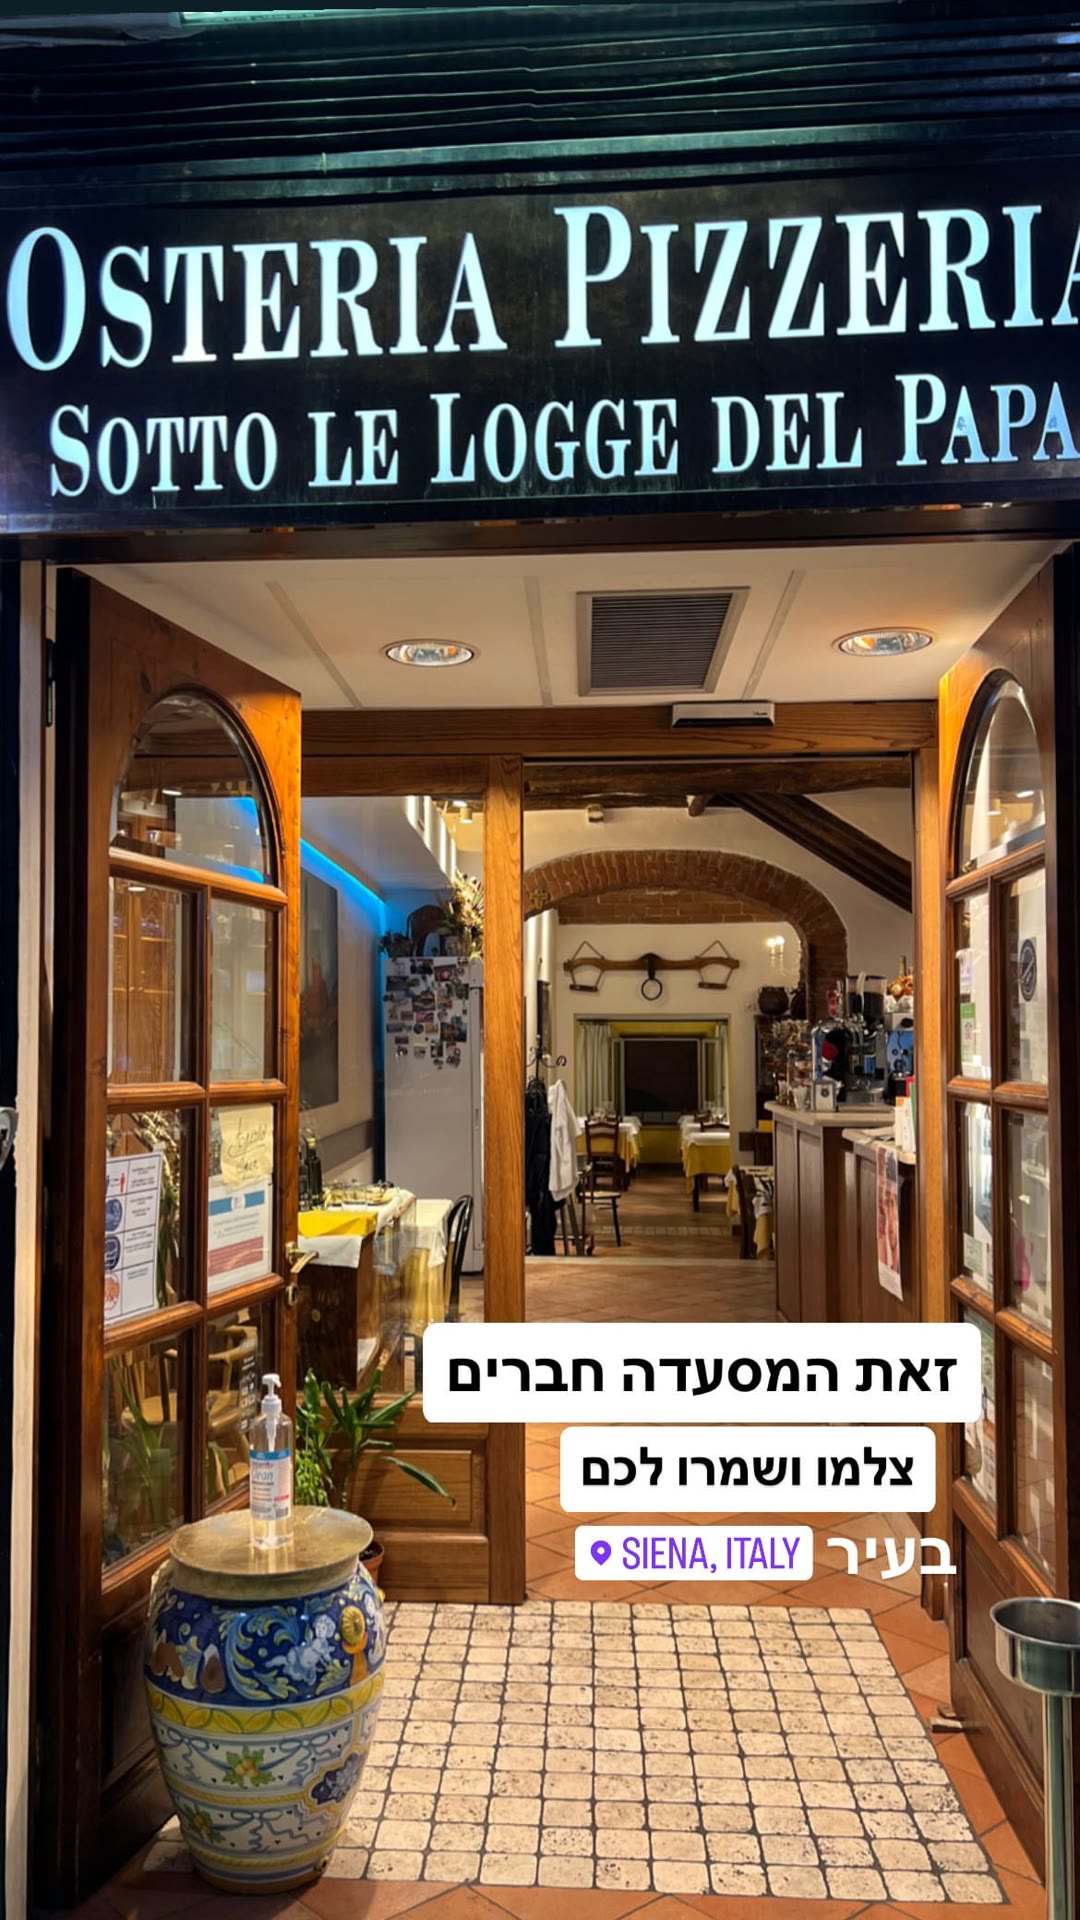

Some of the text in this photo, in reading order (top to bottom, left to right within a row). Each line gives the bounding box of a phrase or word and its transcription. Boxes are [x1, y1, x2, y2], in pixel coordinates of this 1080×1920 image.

[7, 226, 508, 371] OSTERIA
[50, 373, 1080, 497] SOTTO LE LOGGE DEL PAPA
